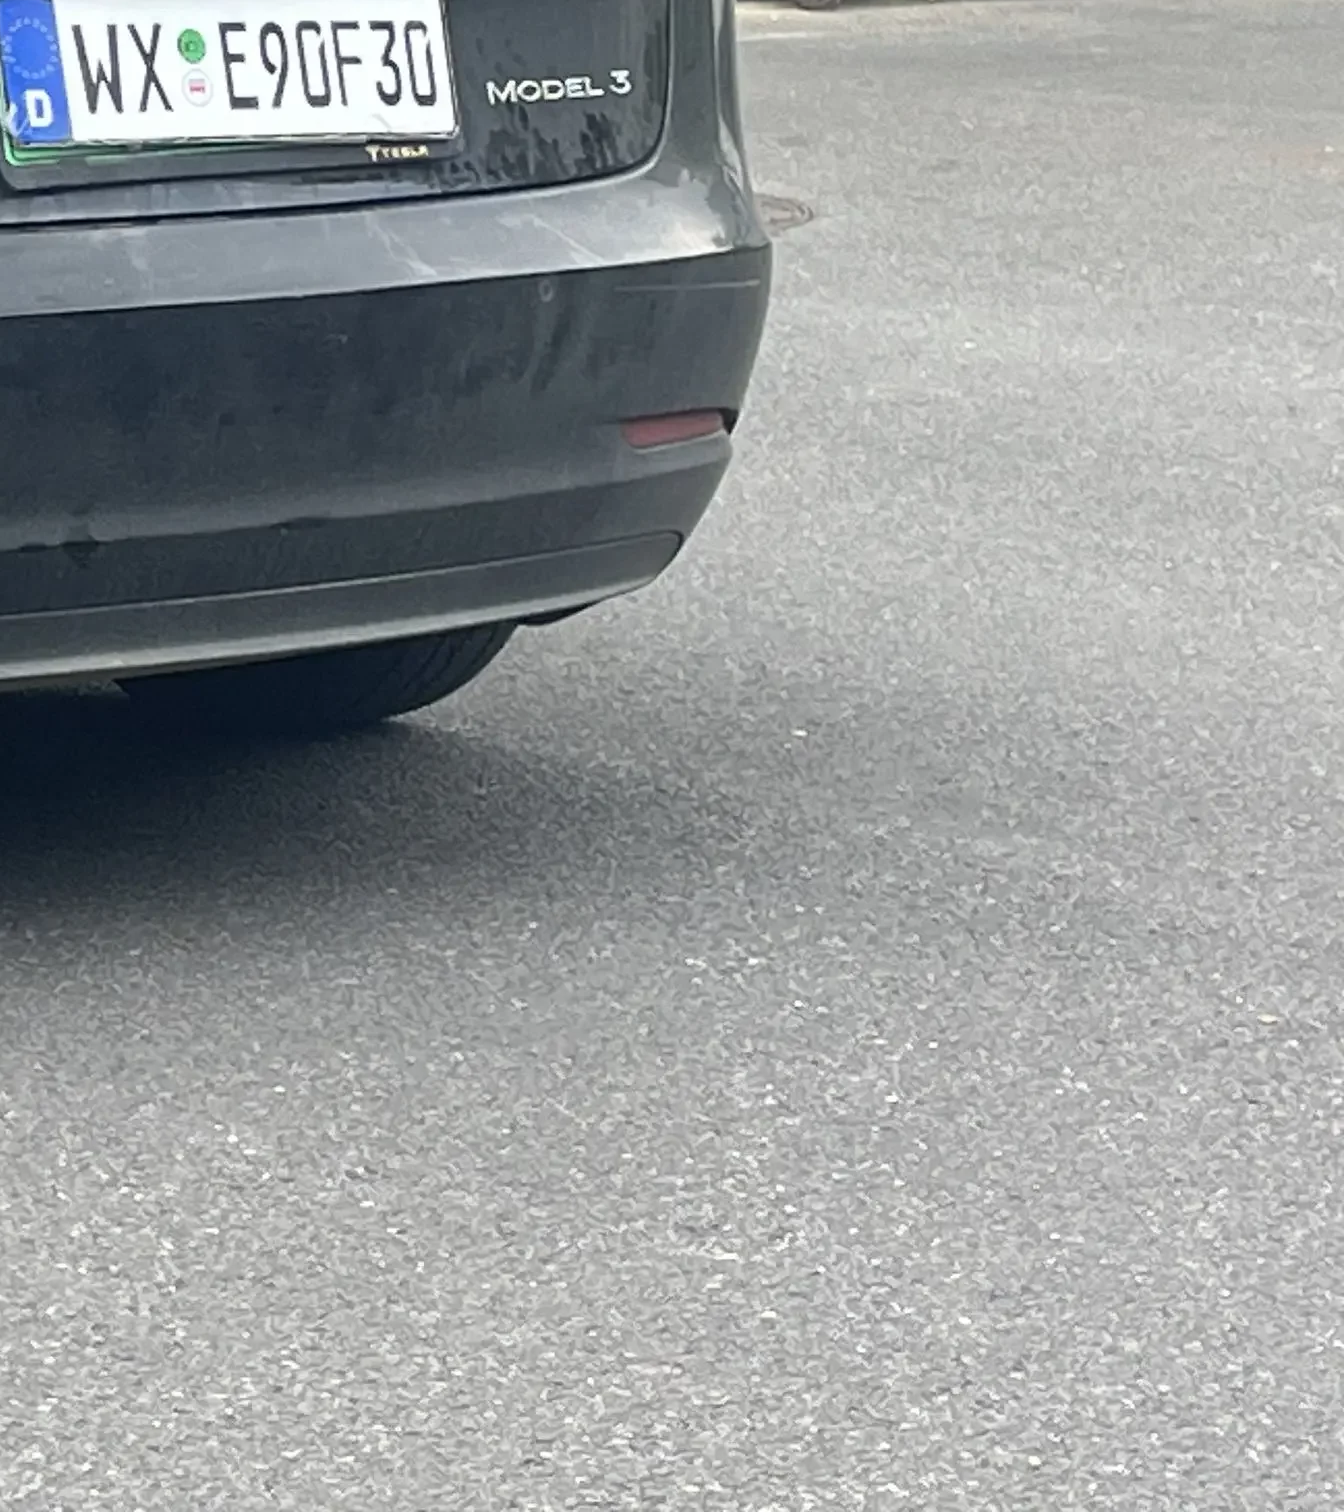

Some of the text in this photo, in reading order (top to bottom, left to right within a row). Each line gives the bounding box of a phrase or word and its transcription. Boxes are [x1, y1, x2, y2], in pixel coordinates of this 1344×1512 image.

[485, 69, 632, 106] MODEL 3
[24, 90, 54, 128] D
